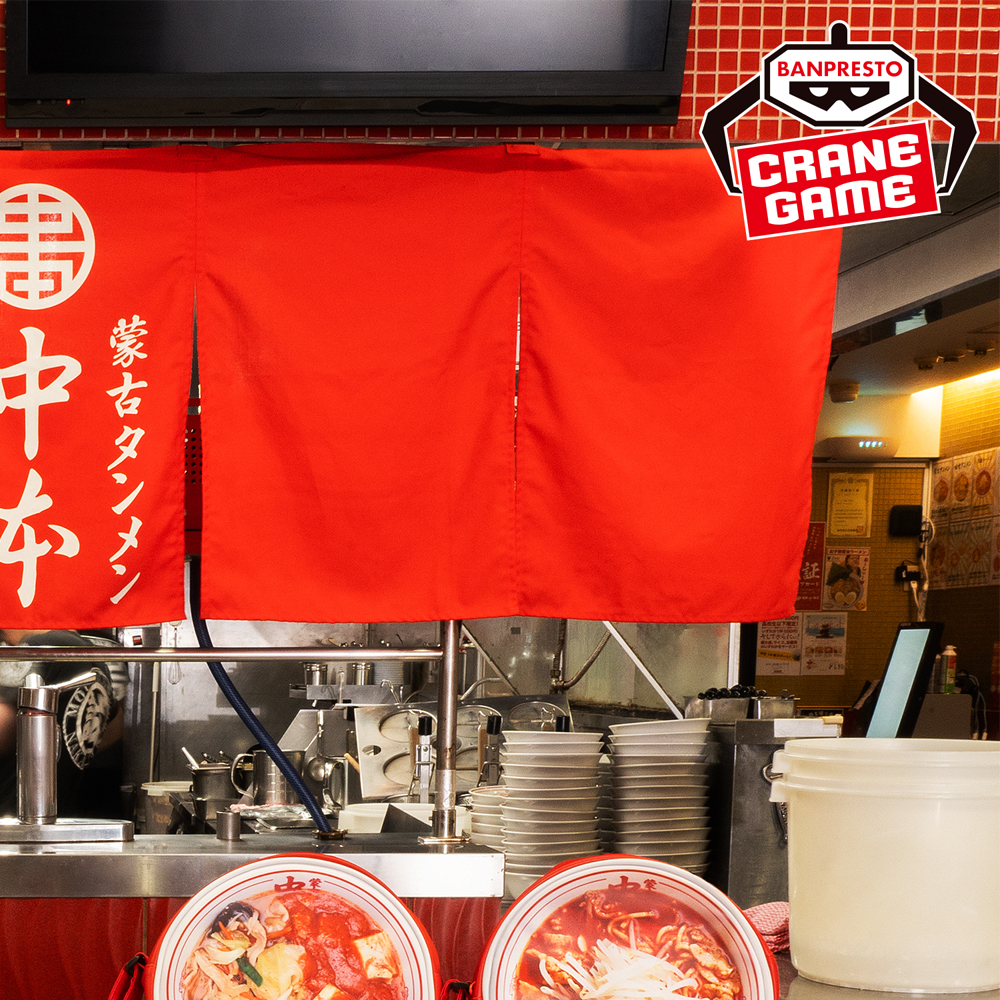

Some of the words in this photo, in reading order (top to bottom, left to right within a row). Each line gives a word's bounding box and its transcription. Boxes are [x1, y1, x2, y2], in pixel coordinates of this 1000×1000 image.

[106, 314, 148, 604] 蒙古タンメン
